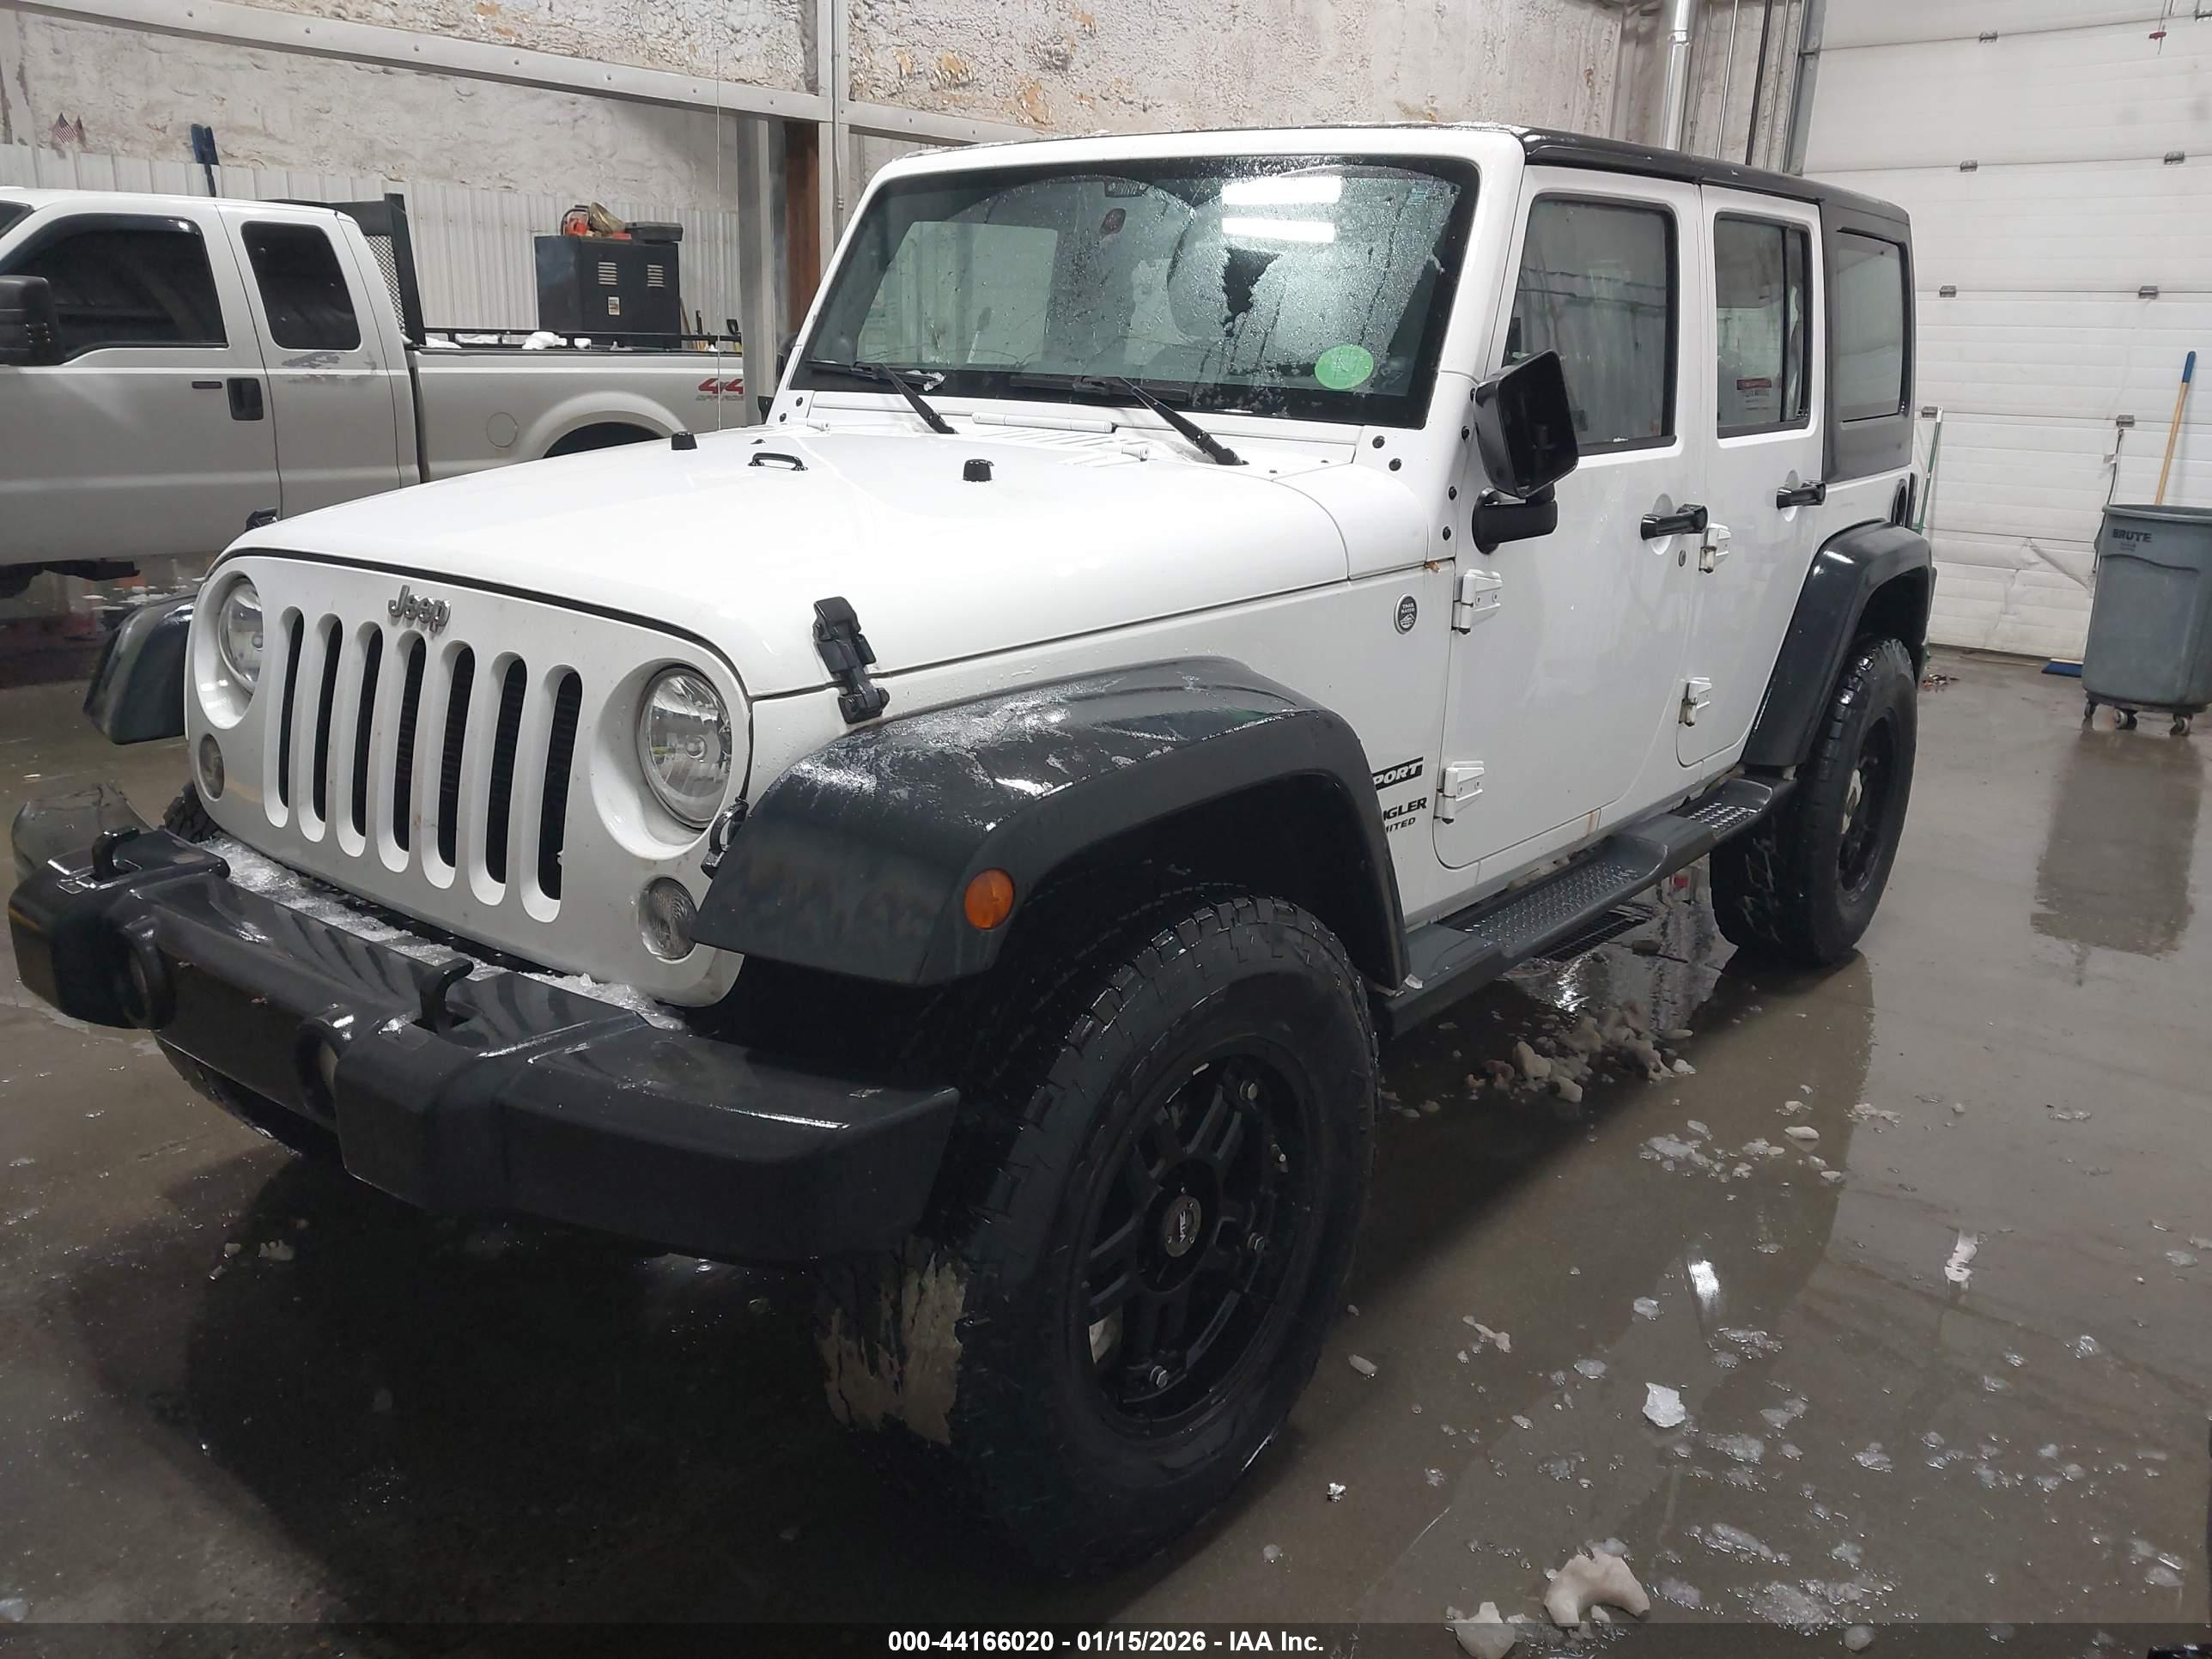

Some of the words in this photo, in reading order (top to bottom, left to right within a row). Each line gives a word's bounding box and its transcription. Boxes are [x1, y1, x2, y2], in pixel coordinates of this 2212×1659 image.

[2113, 529, 2152, 543] BRUTE
[388, 585, 450, 633] Jeep
[1373, 762, 1424, 785] PORT
